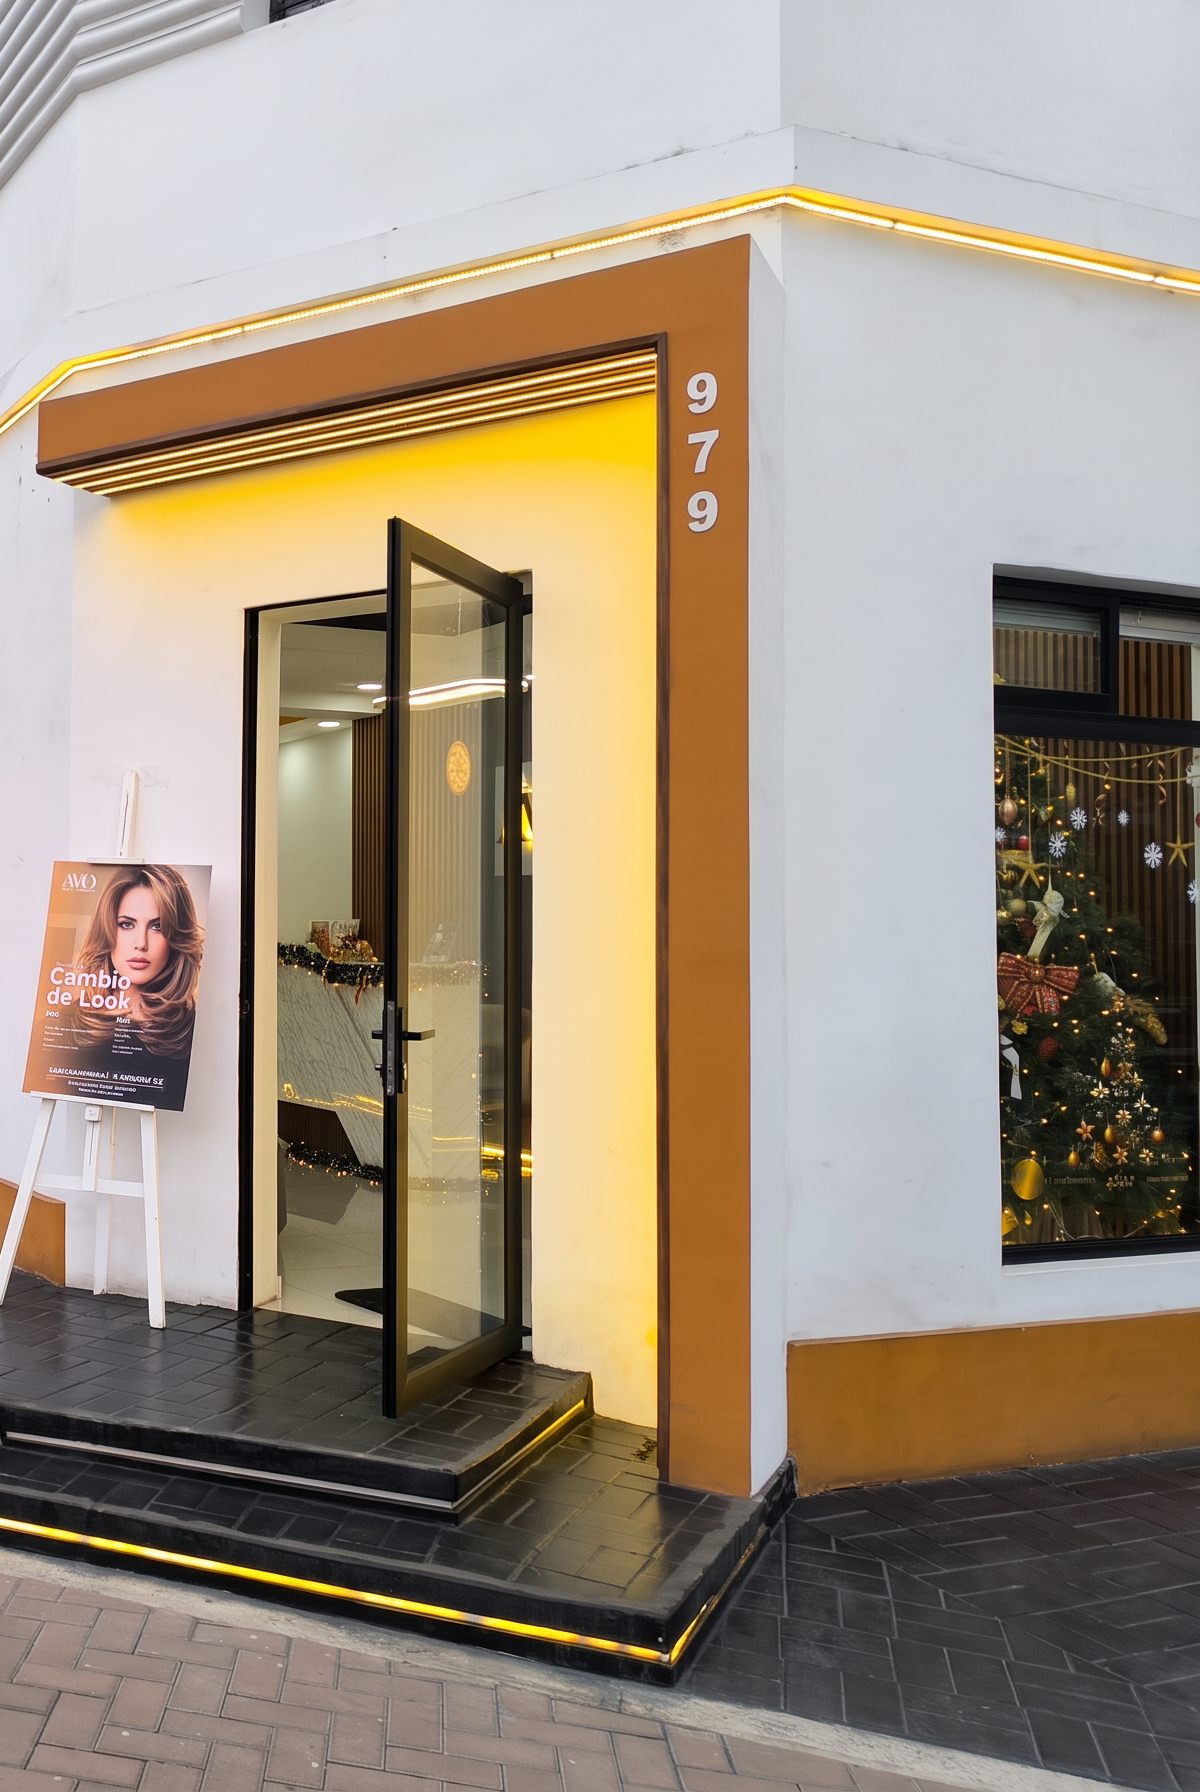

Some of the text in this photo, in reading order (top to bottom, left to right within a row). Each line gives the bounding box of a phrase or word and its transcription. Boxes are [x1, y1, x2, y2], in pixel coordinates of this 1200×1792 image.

[686, 372, 720, 533] 979
[61, 872, 97, 889] AVO
[49, 966, 131, 990] Cambio
[46, 986, 131, 1010] de Look
